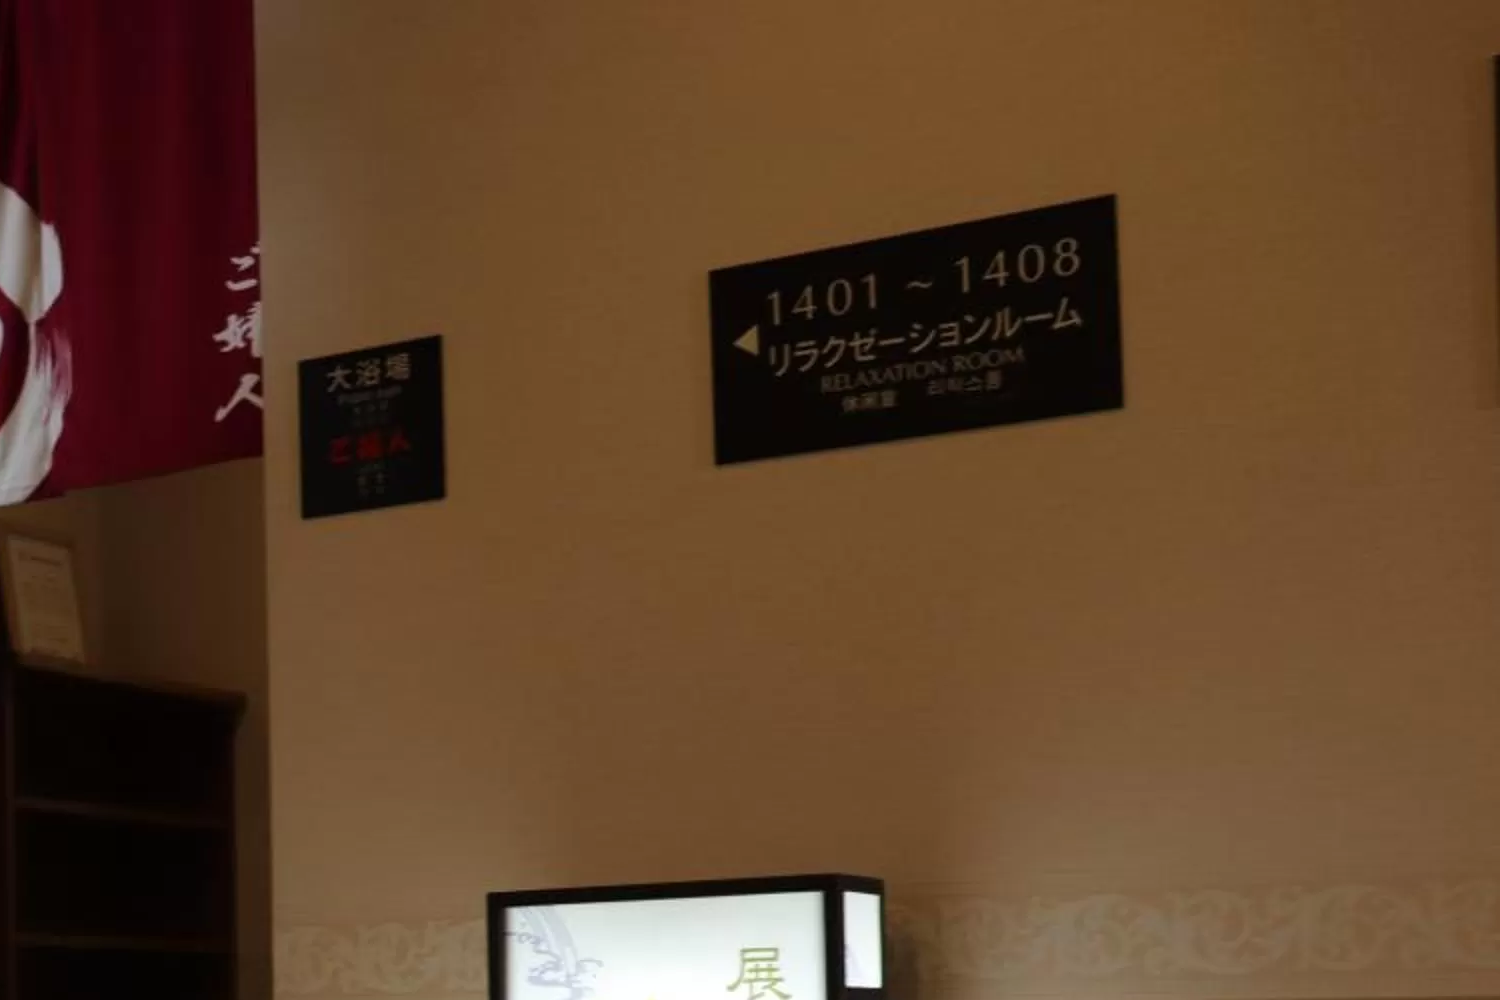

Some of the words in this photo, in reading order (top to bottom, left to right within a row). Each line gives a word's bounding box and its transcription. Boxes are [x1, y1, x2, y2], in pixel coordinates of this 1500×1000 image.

[766, 272, 880, 327] 1401
[954, 237, 1082, 294] 1408
[768, 296, 1083, 377] リラクゼーションルーム
[820, 359, 948, 393] RELAXATION
[952, 348, 1025, 374] ROOM
